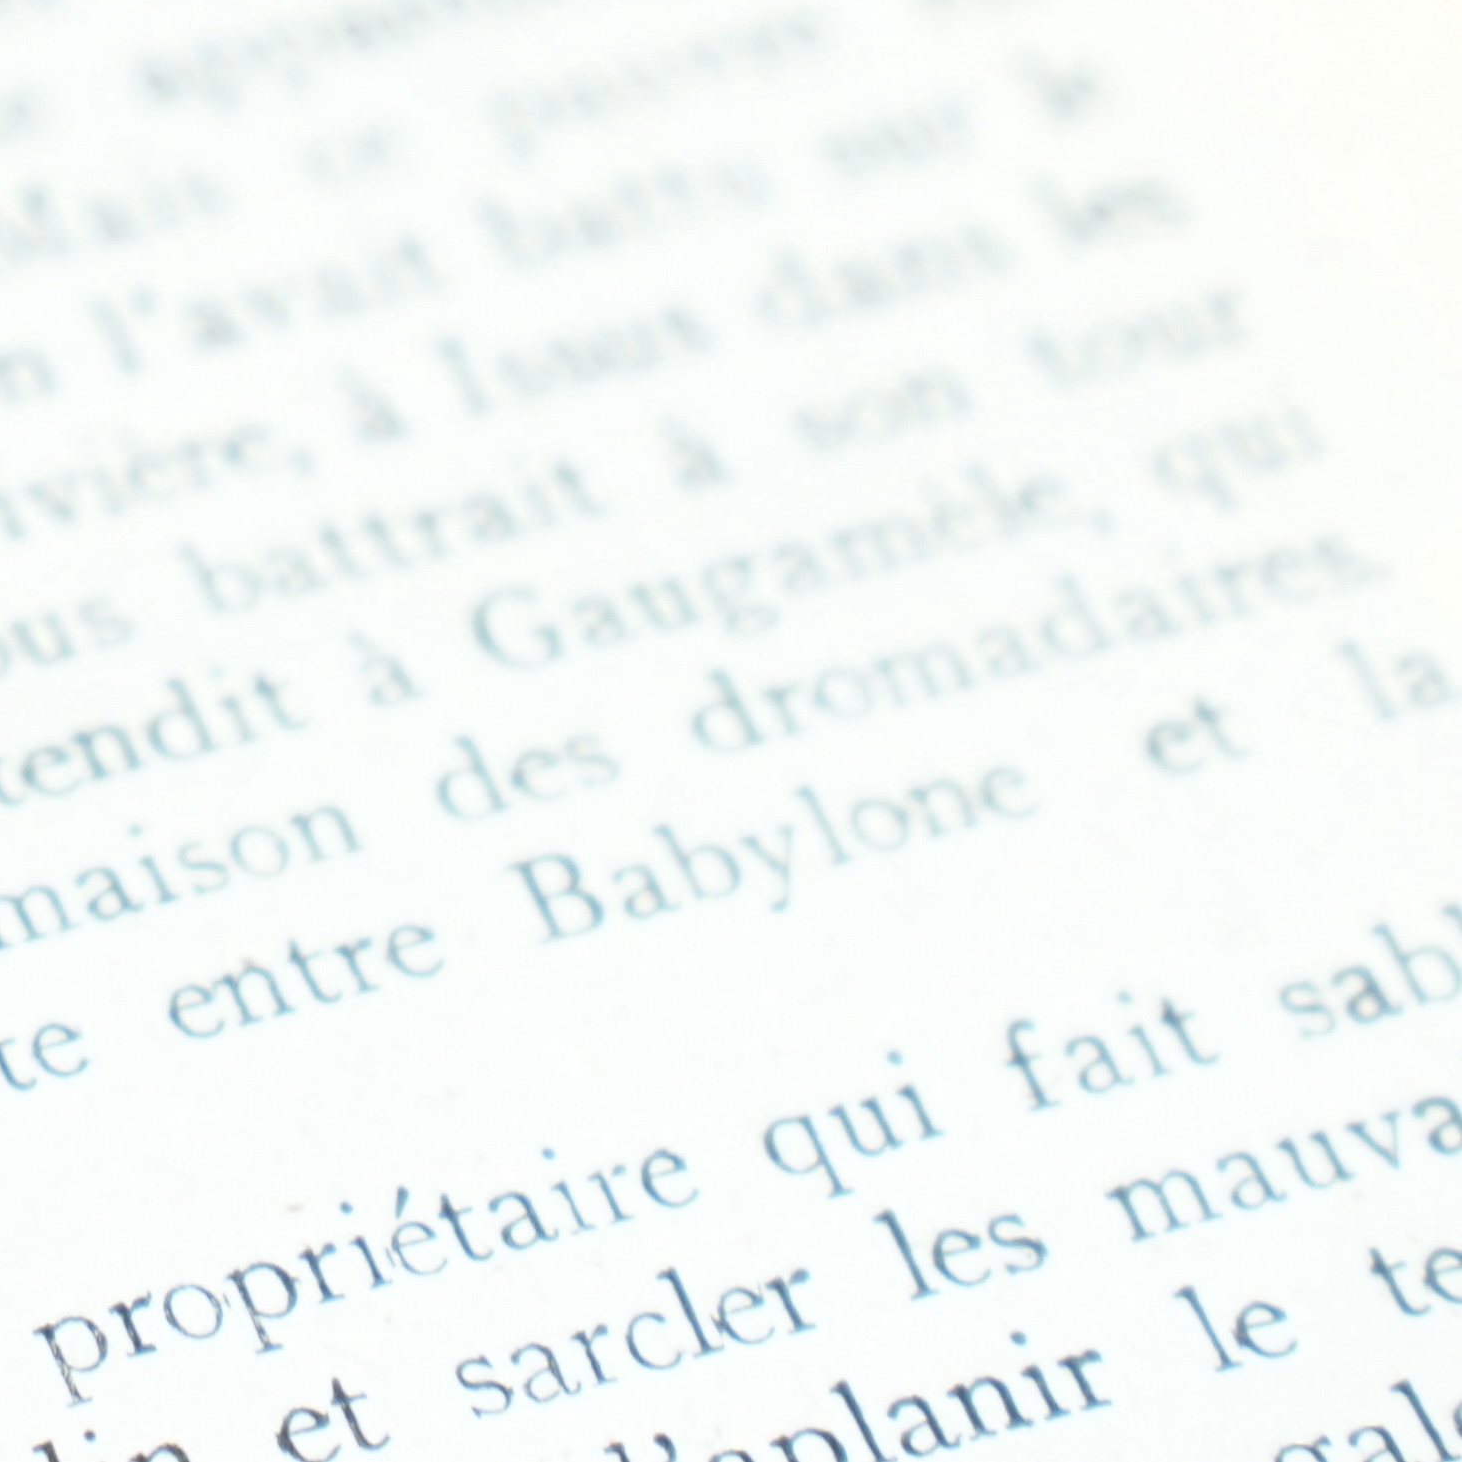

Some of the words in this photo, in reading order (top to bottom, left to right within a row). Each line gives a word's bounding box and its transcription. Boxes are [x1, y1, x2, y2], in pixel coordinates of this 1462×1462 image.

[173, 454, 608, 617] battrait
[350, 630, 425, 709] à
[1143, 400, 1332, 517] qui
[163, 915, 447, 1042] entre
[506, 761, 1038, 946] Babylone
[1141, 694, 1251, 777] et
[1332, 633, 1462, 727] la
[429, 729, 623, 821] des
[32, 1141, 701, 1407] propriétaire
[759, 1047, 945, 1201] qui
[1003, 989, 1219, 1115] fait
[1279, 903, 1462, 1041] sab
[274, 1375, 391, 1462] et
[449, 1262, 814, 1422] sarcler
[870, 1204, 1053, 1303] les
[1170, 1280, 1291, 1376] le
